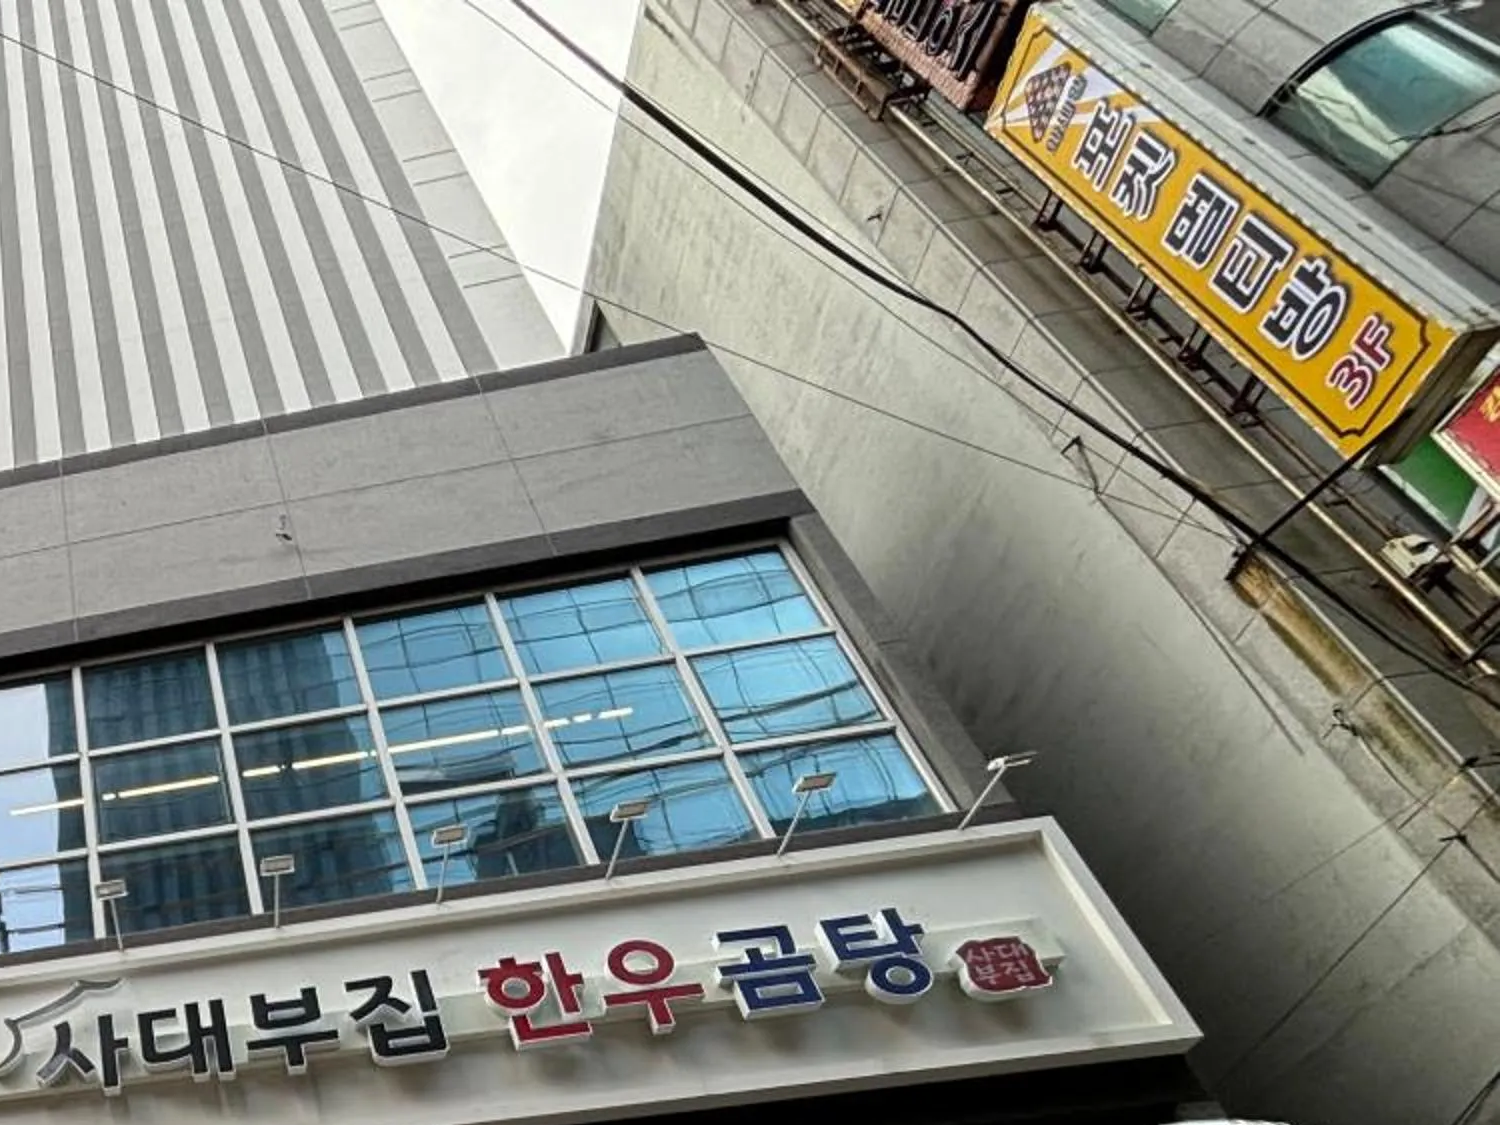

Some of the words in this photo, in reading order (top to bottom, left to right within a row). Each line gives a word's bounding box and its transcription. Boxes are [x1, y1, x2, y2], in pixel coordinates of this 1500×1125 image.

[1072, 100, 1176, 220] 포켓
[1161, 170, 1347, 360] 멀티방
[1326, 315, 1391, 409] 3F
[36, 969, 449, 1095] 사대부집
[478, 950, 704, 1051] 한우
[713, 907, 934, 1020] 곰탕
